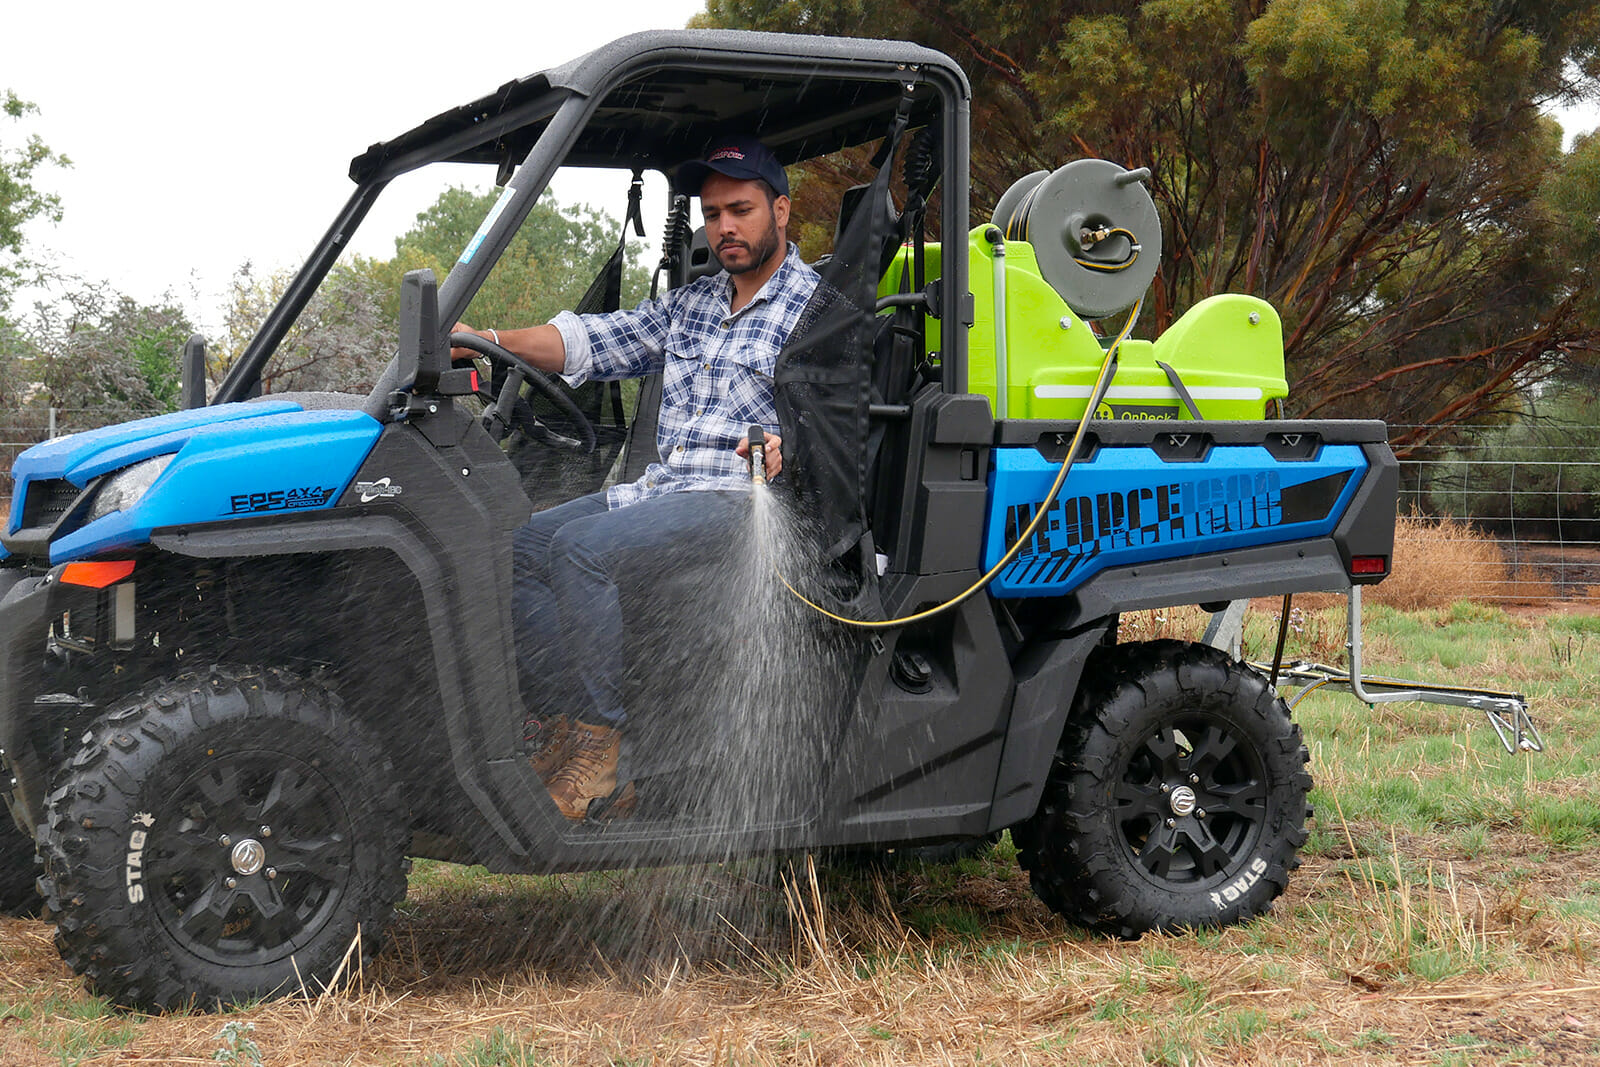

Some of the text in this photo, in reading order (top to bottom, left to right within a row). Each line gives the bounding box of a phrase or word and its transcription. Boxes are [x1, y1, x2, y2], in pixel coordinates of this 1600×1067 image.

[230, 490, 286, 512] EPS
[126, 830, 148, 905] STAG
[1221, 857, 1268, 902] STAG
